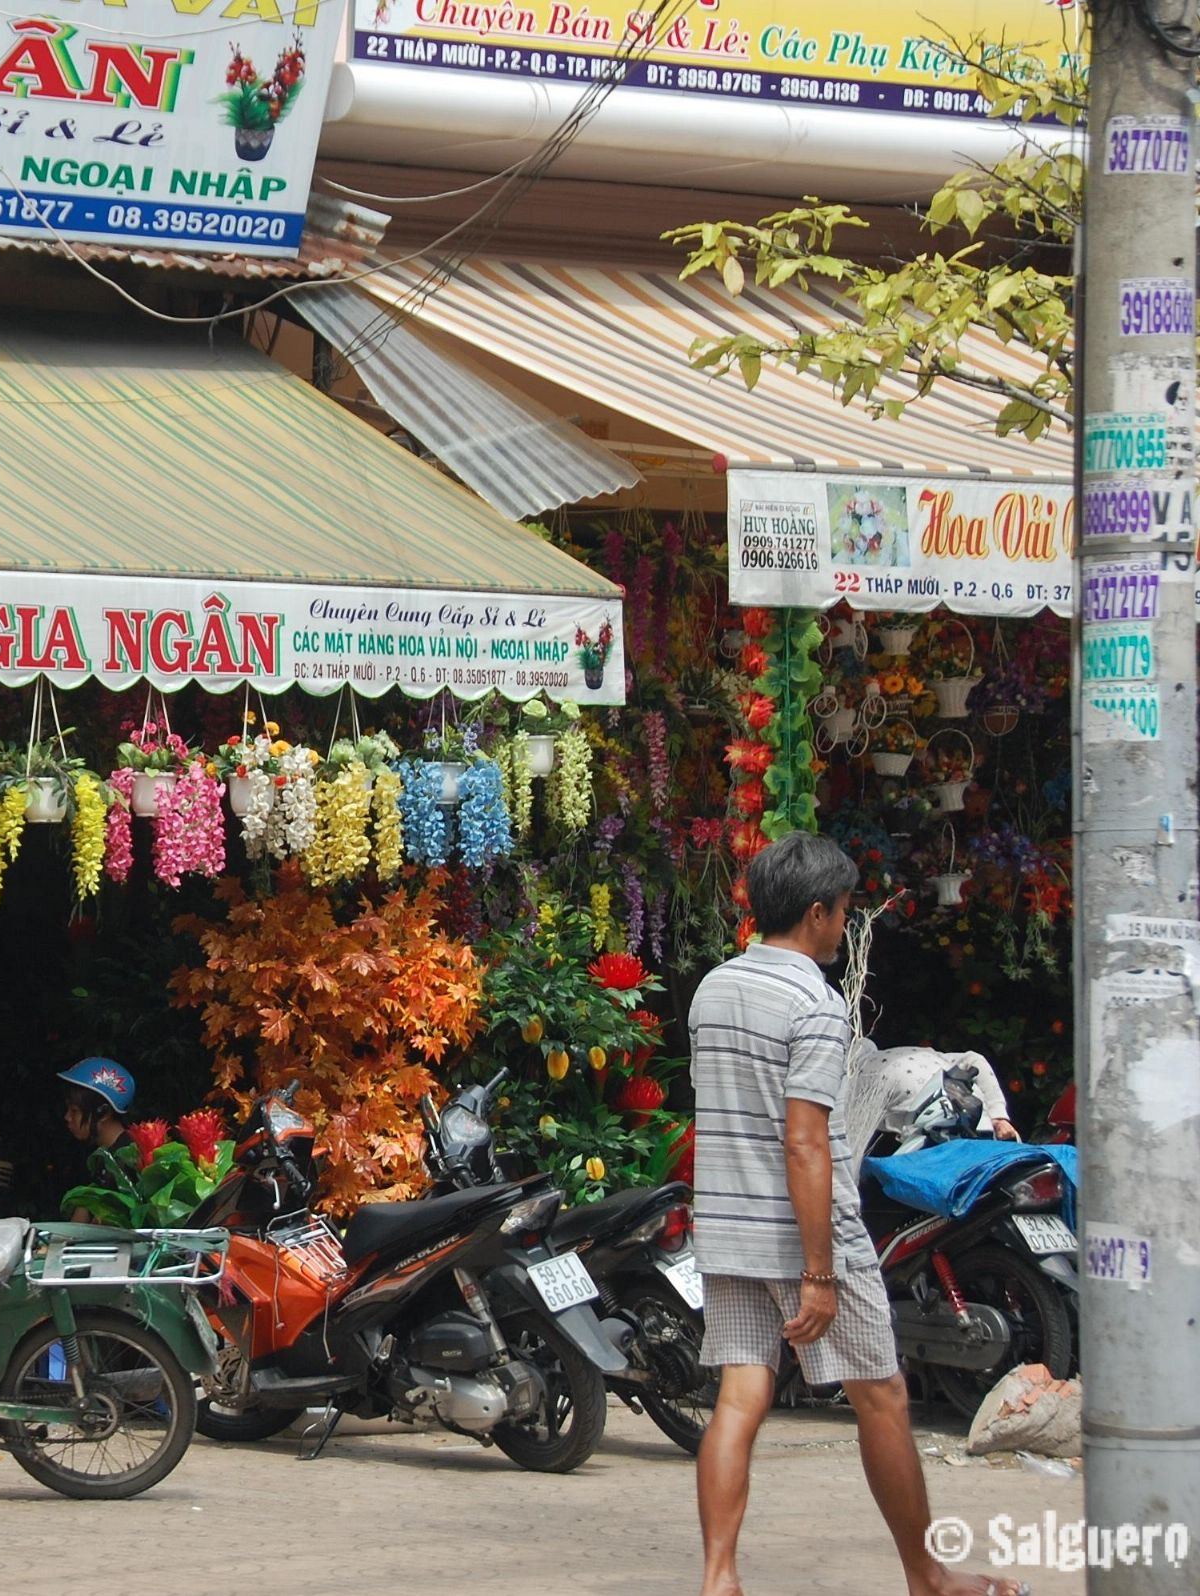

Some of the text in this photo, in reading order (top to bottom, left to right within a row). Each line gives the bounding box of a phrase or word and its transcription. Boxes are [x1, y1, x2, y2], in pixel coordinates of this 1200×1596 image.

[416, 0, 536, 36] Chuyên
[546, 2, 611, 40] Bán
[667, 17, 691, 49] &
[703, 19, 750, 55] Lẻ:
[760, 26, 817, 61] Các
[827, 32, 888, 75] Phụ
[367, 35, 389, 58] 22
[394, 38, 438, 63] THÁP
[678, 67, 762, 93] 3950.9765
[780, 77, 861, 103] 3950.6136
[45, 118, 76, 140] &
[93, 120, 166, 147] Lẻ
[21, 155, 154, 195] NGOẠI
[169, 167, 288, 205] NHẬP
[107, 204, 286, 241] 08.39520020
[743, 513, 815, 535] HUY HOÀNG
[918, 489, 989, 560] Hoa
[743, 535, 815, 551] 0909.741277
[741, 549, 818, 570] 0906.926616
[834, 571, 860, 593] 22
[865, 573, 903, 594] THÁP
[907, 575, 940, 596] MƯỜI
[954, 581, 977, 598] P.2
[991, 583, 1014, 599] Q.6
[1026, 585, 1048, 600] ĐT:
[309, 598, 378, 624] Chuyên
[385, 601, 432, 628] Cung
[438, 603, 474, 630] Cấp
[505, 610, 517, 627] &
[102, 591, 286, 677] NGÂN
[293, 625, 569, 665] CÁC MẶT HÀNG HOA VẢI NỘI NGOẠI NHẬP
[294, 660, 569, 688] ĐC: 24 THÁP MƯỜI P.2 Q.6 ĐT: 08.35051877 08.39520020
[544, 1277, 593, 1307] 660.60
